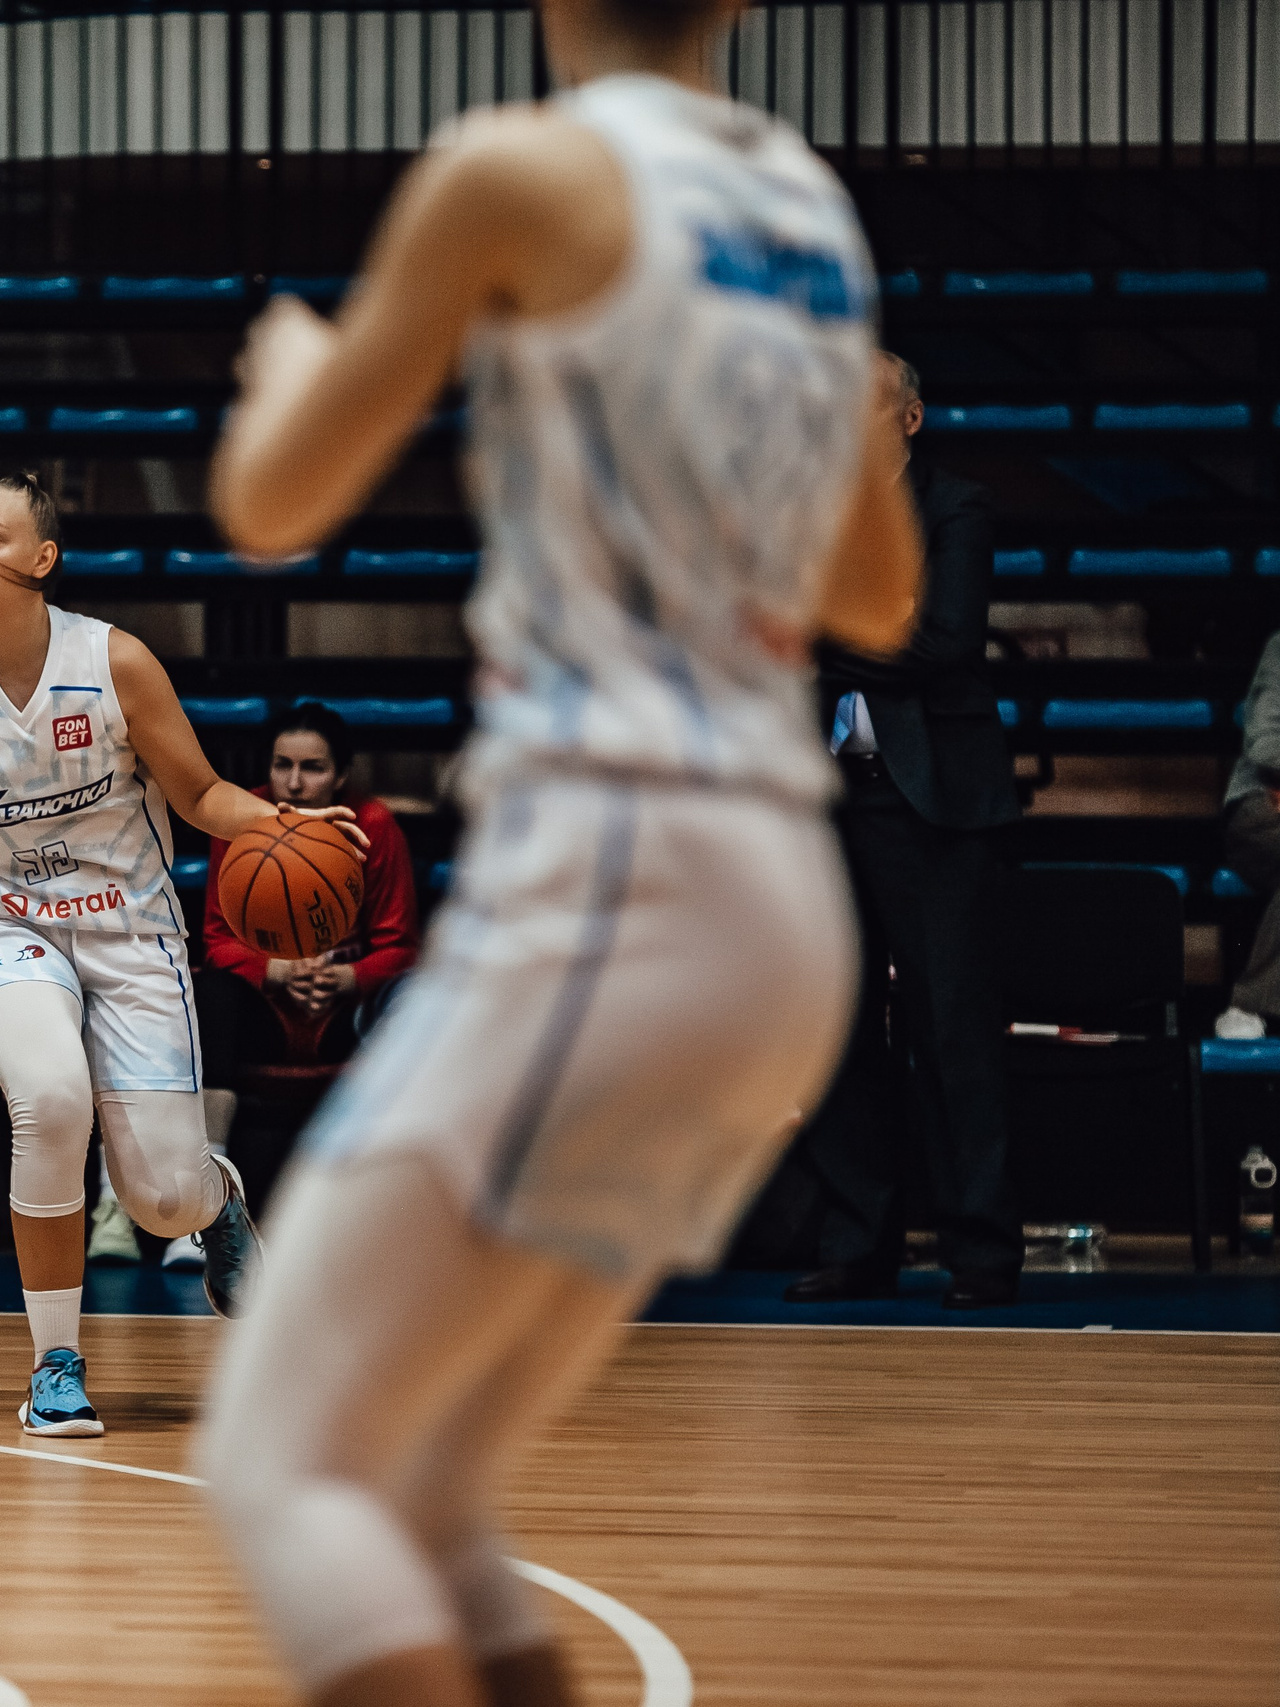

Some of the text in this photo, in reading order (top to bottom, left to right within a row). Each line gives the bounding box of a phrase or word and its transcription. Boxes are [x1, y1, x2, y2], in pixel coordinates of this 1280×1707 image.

[56, 718, 87, 734] FON
[58, 730, 89, 747] BET
[35, 883, 127, 919] летай
